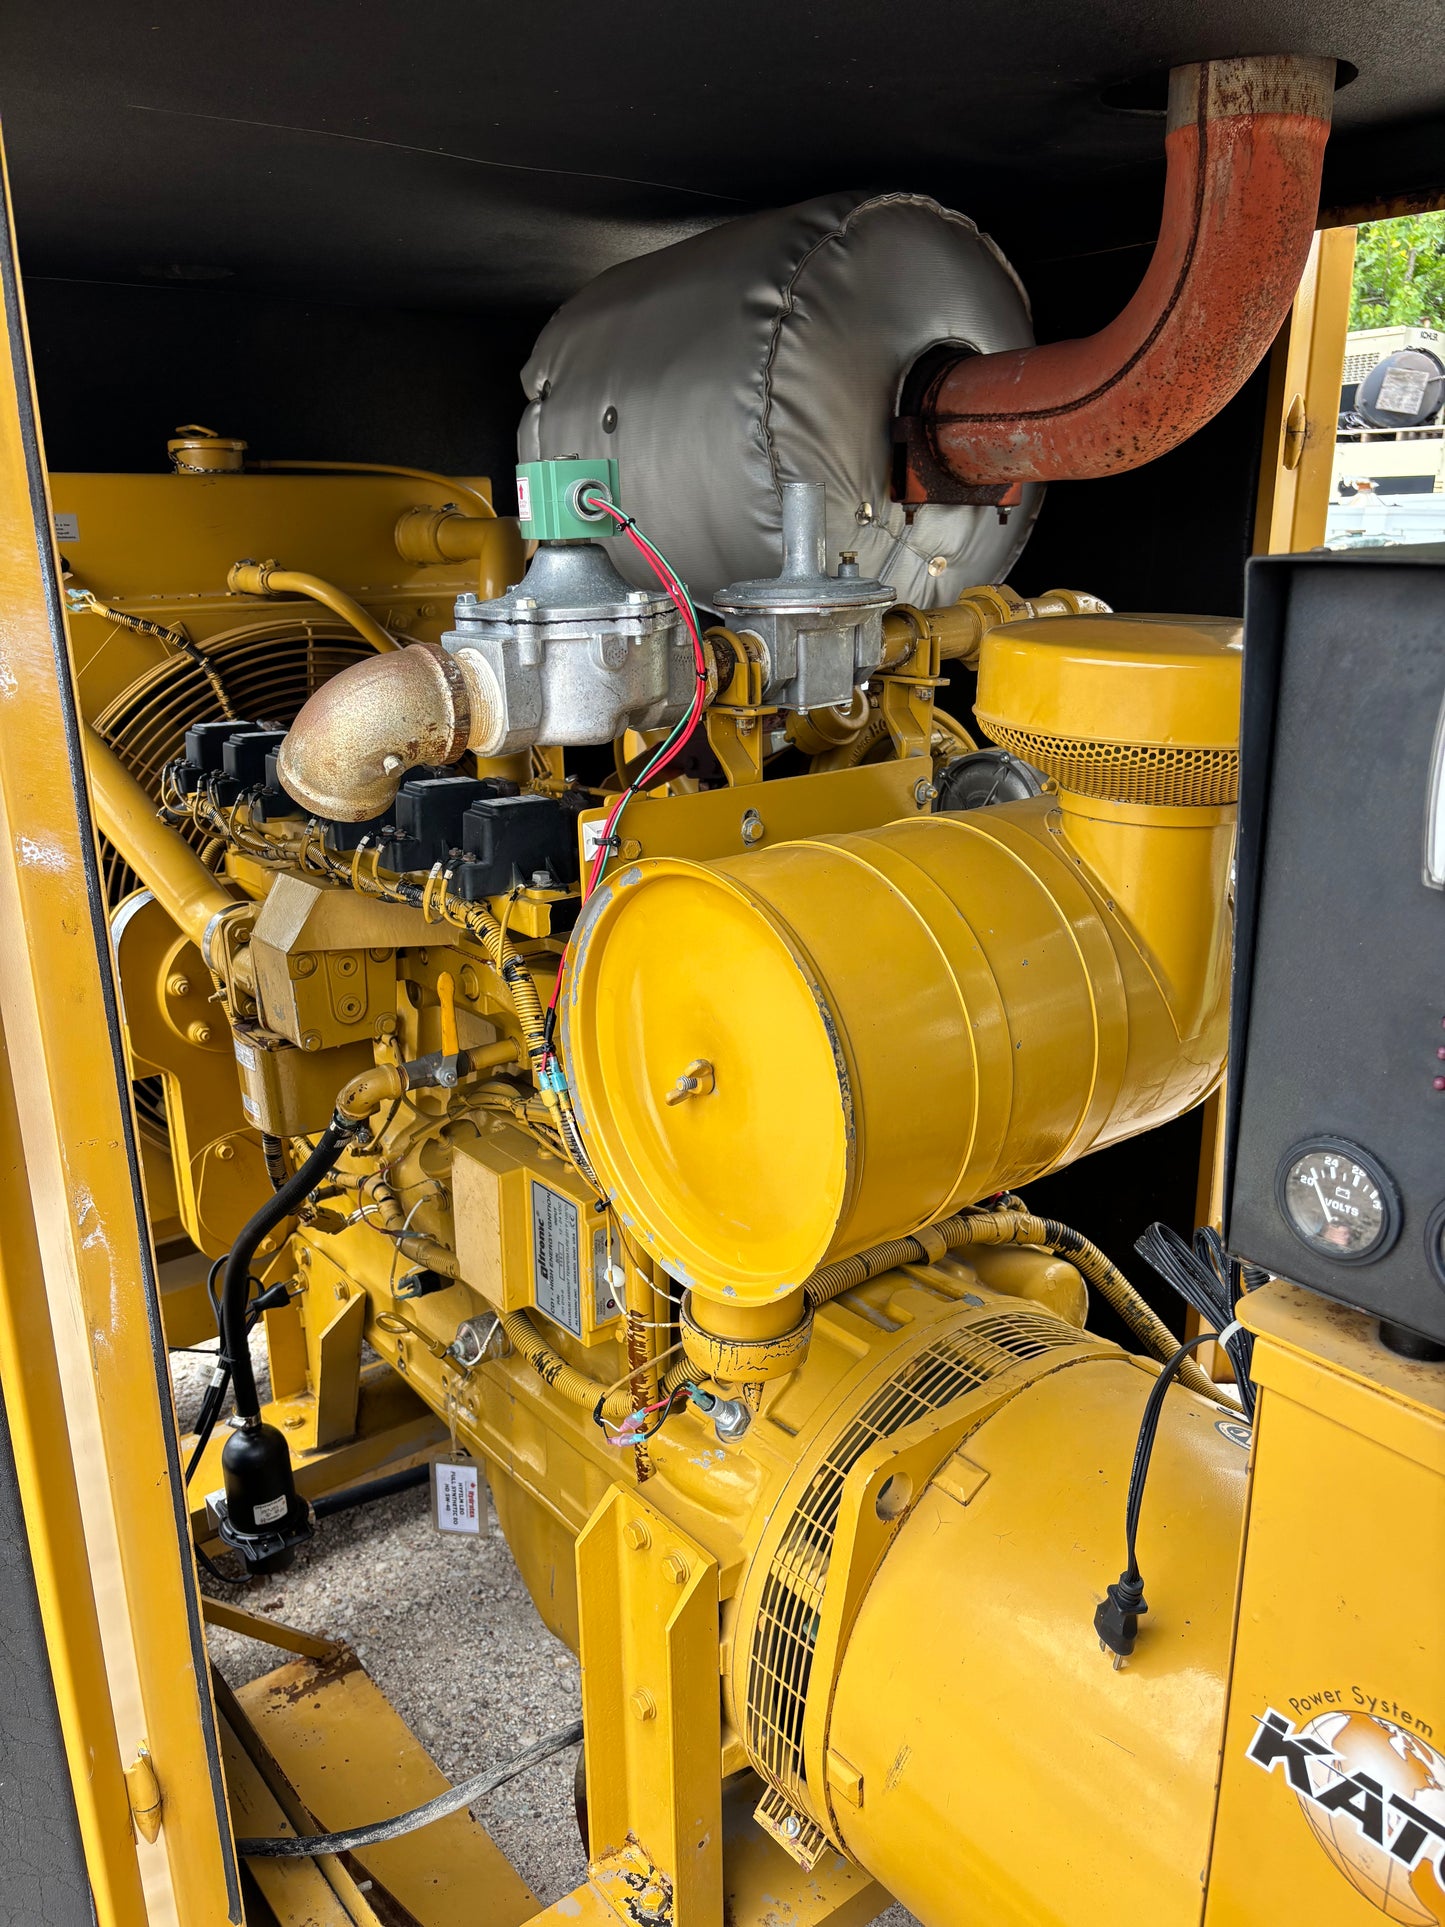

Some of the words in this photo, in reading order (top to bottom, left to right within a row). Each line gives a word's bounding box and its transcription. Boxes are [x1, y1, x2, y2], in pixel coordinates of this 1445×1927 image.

[1324, 1156, 1339, 1168] 24
[1300, 1175, 1314, 1187] 20
[1324, 1197, 1359, 1217] VOLTS
[537, 1219, 549, 1281] altronic
[1288, 1688, 1342, 1716] Power
[1351, 1685, 1434, 1738] System
[1247, 1707, 1445, 1893] KAT
